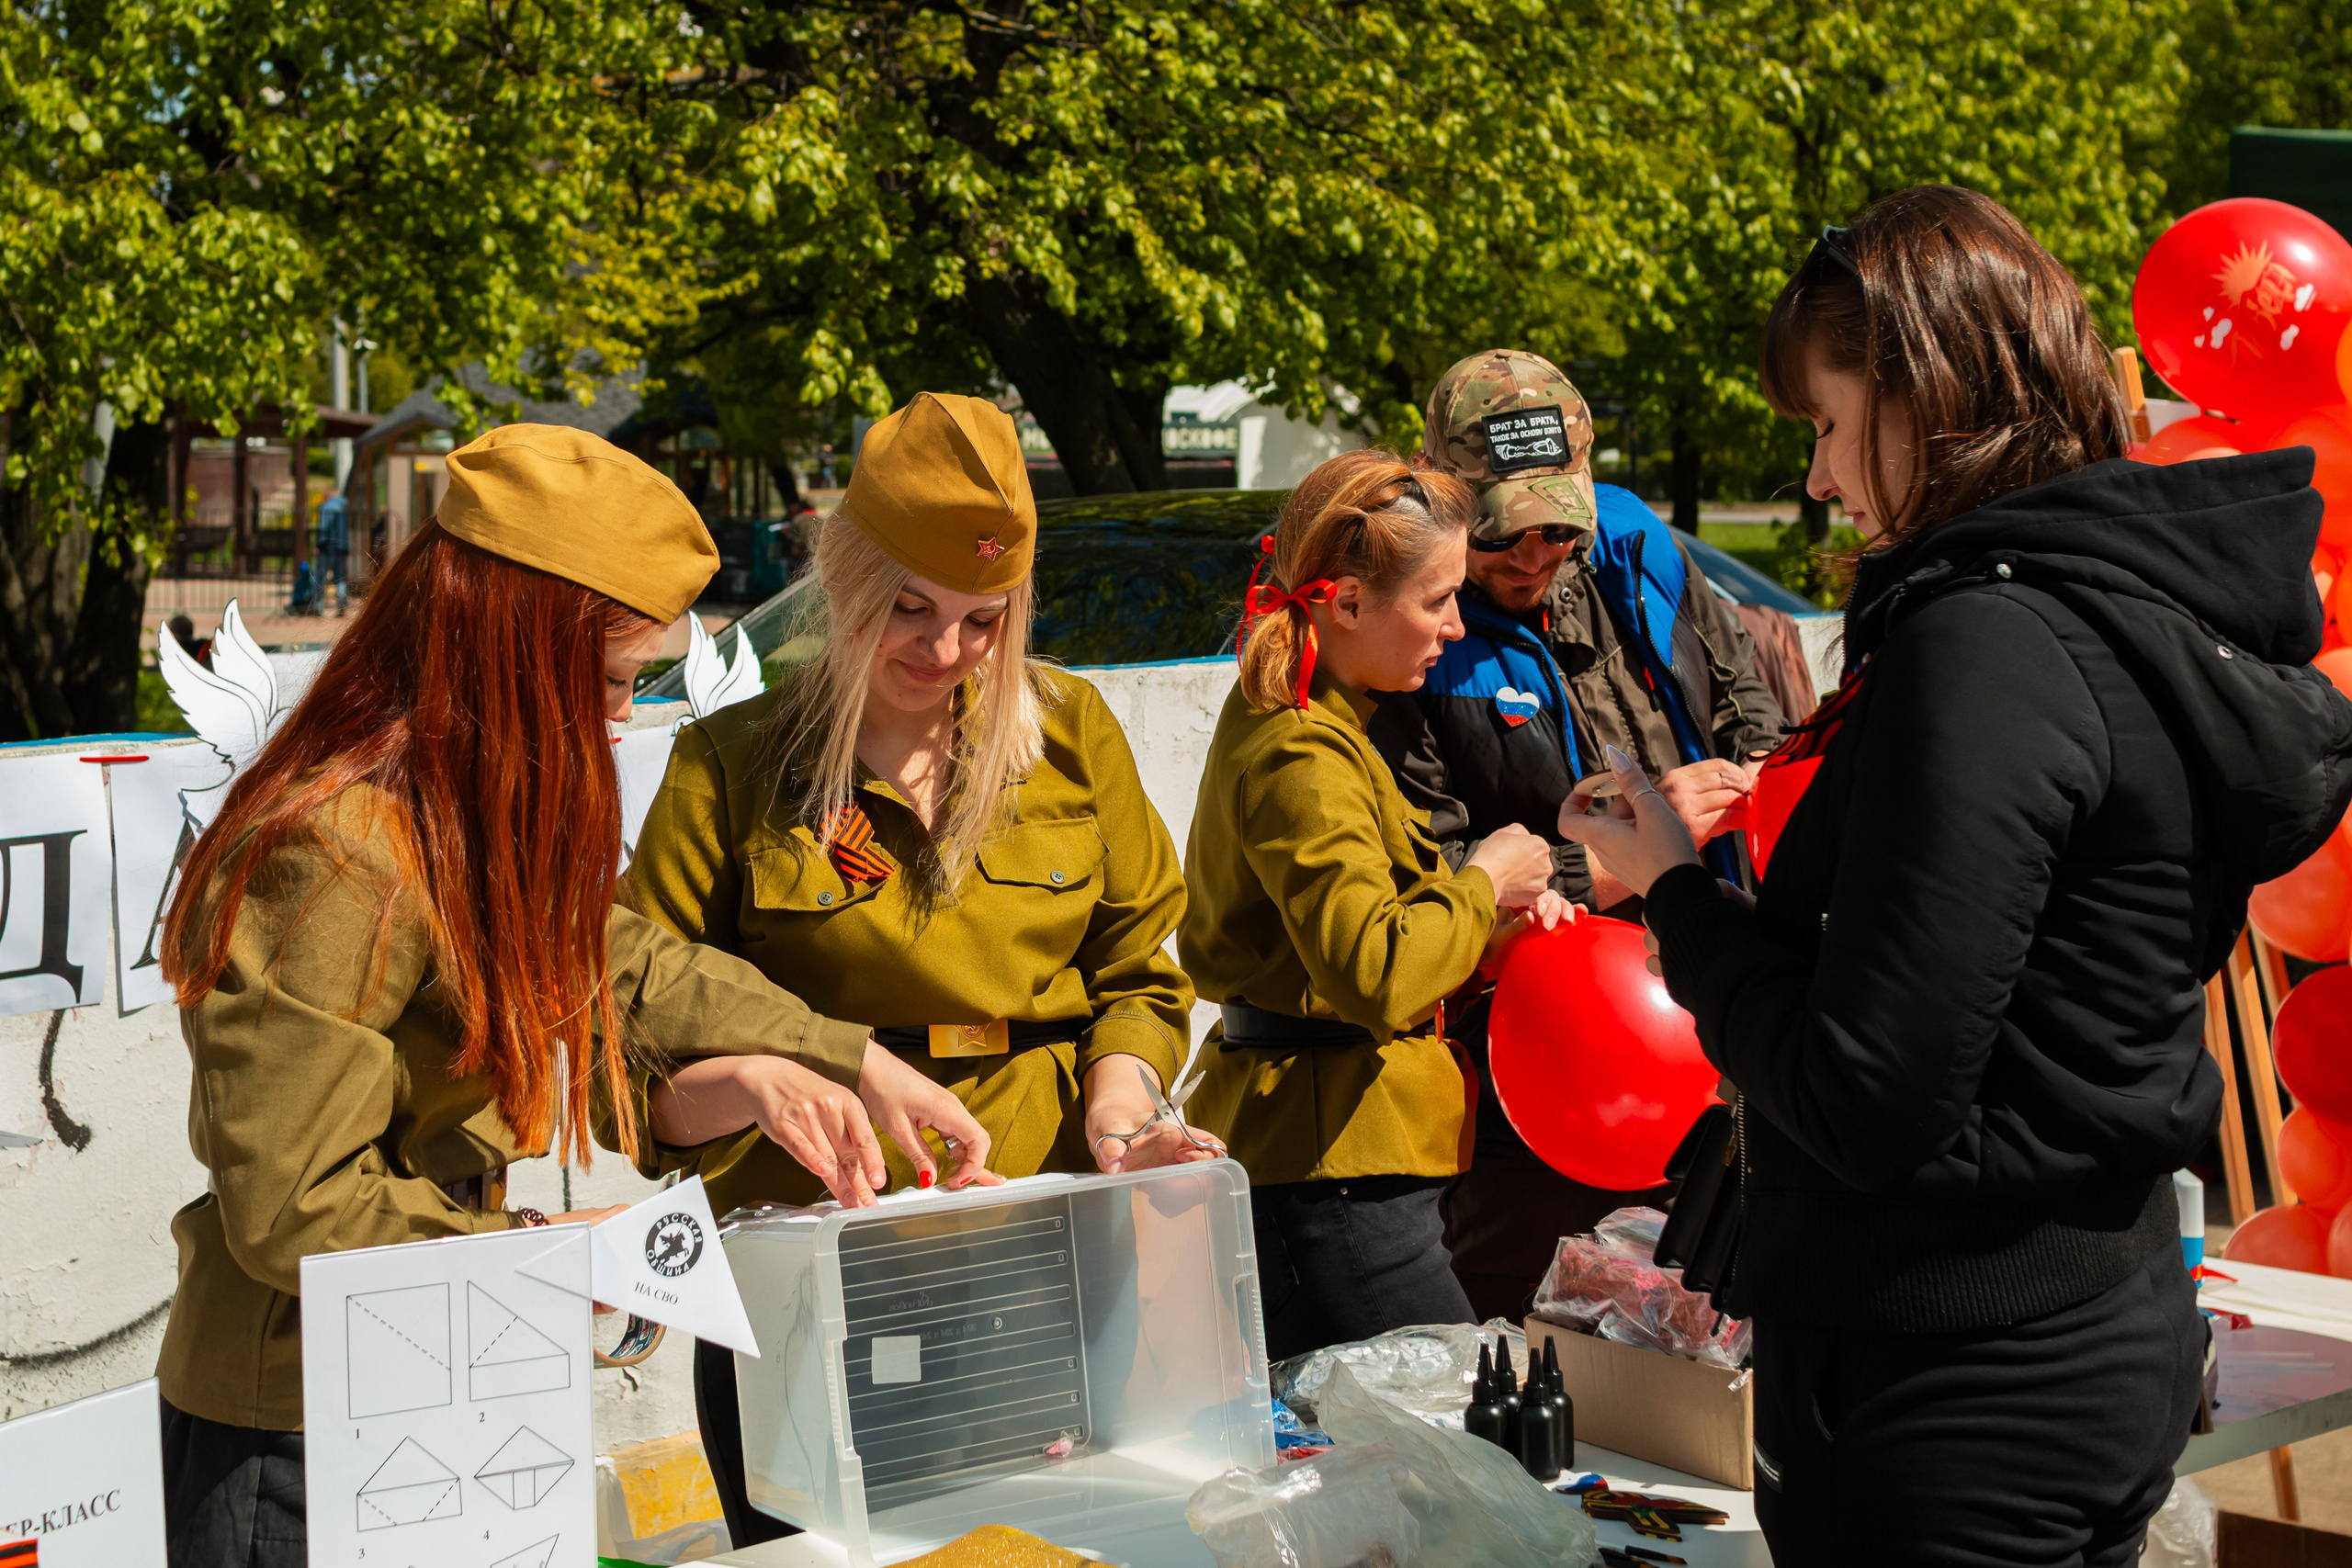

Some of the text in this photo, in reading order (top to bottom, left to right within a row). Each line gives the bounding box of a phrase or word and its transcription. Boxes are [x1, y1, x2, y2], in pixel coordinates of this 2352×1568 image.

[1489, 415, 1558, 434] БРАТ ЗА БРАТА,
[1489, 434, 1510, 444] ТАКОЕ
[1510, 432, 1520, 440] ЗА
[655, 1213, 703, 1244] РУССКАЯ
[646, 1248, 690, 1277] ОБЩИНА
[634, 1281, 679, 1305] НА СВО
[479, 1412, 486, 1423] 2
[356, 1427, 360, 1439] 1
[482, 1529, 490, 1540] 4
[358, 1548, 366, 1560] 3
